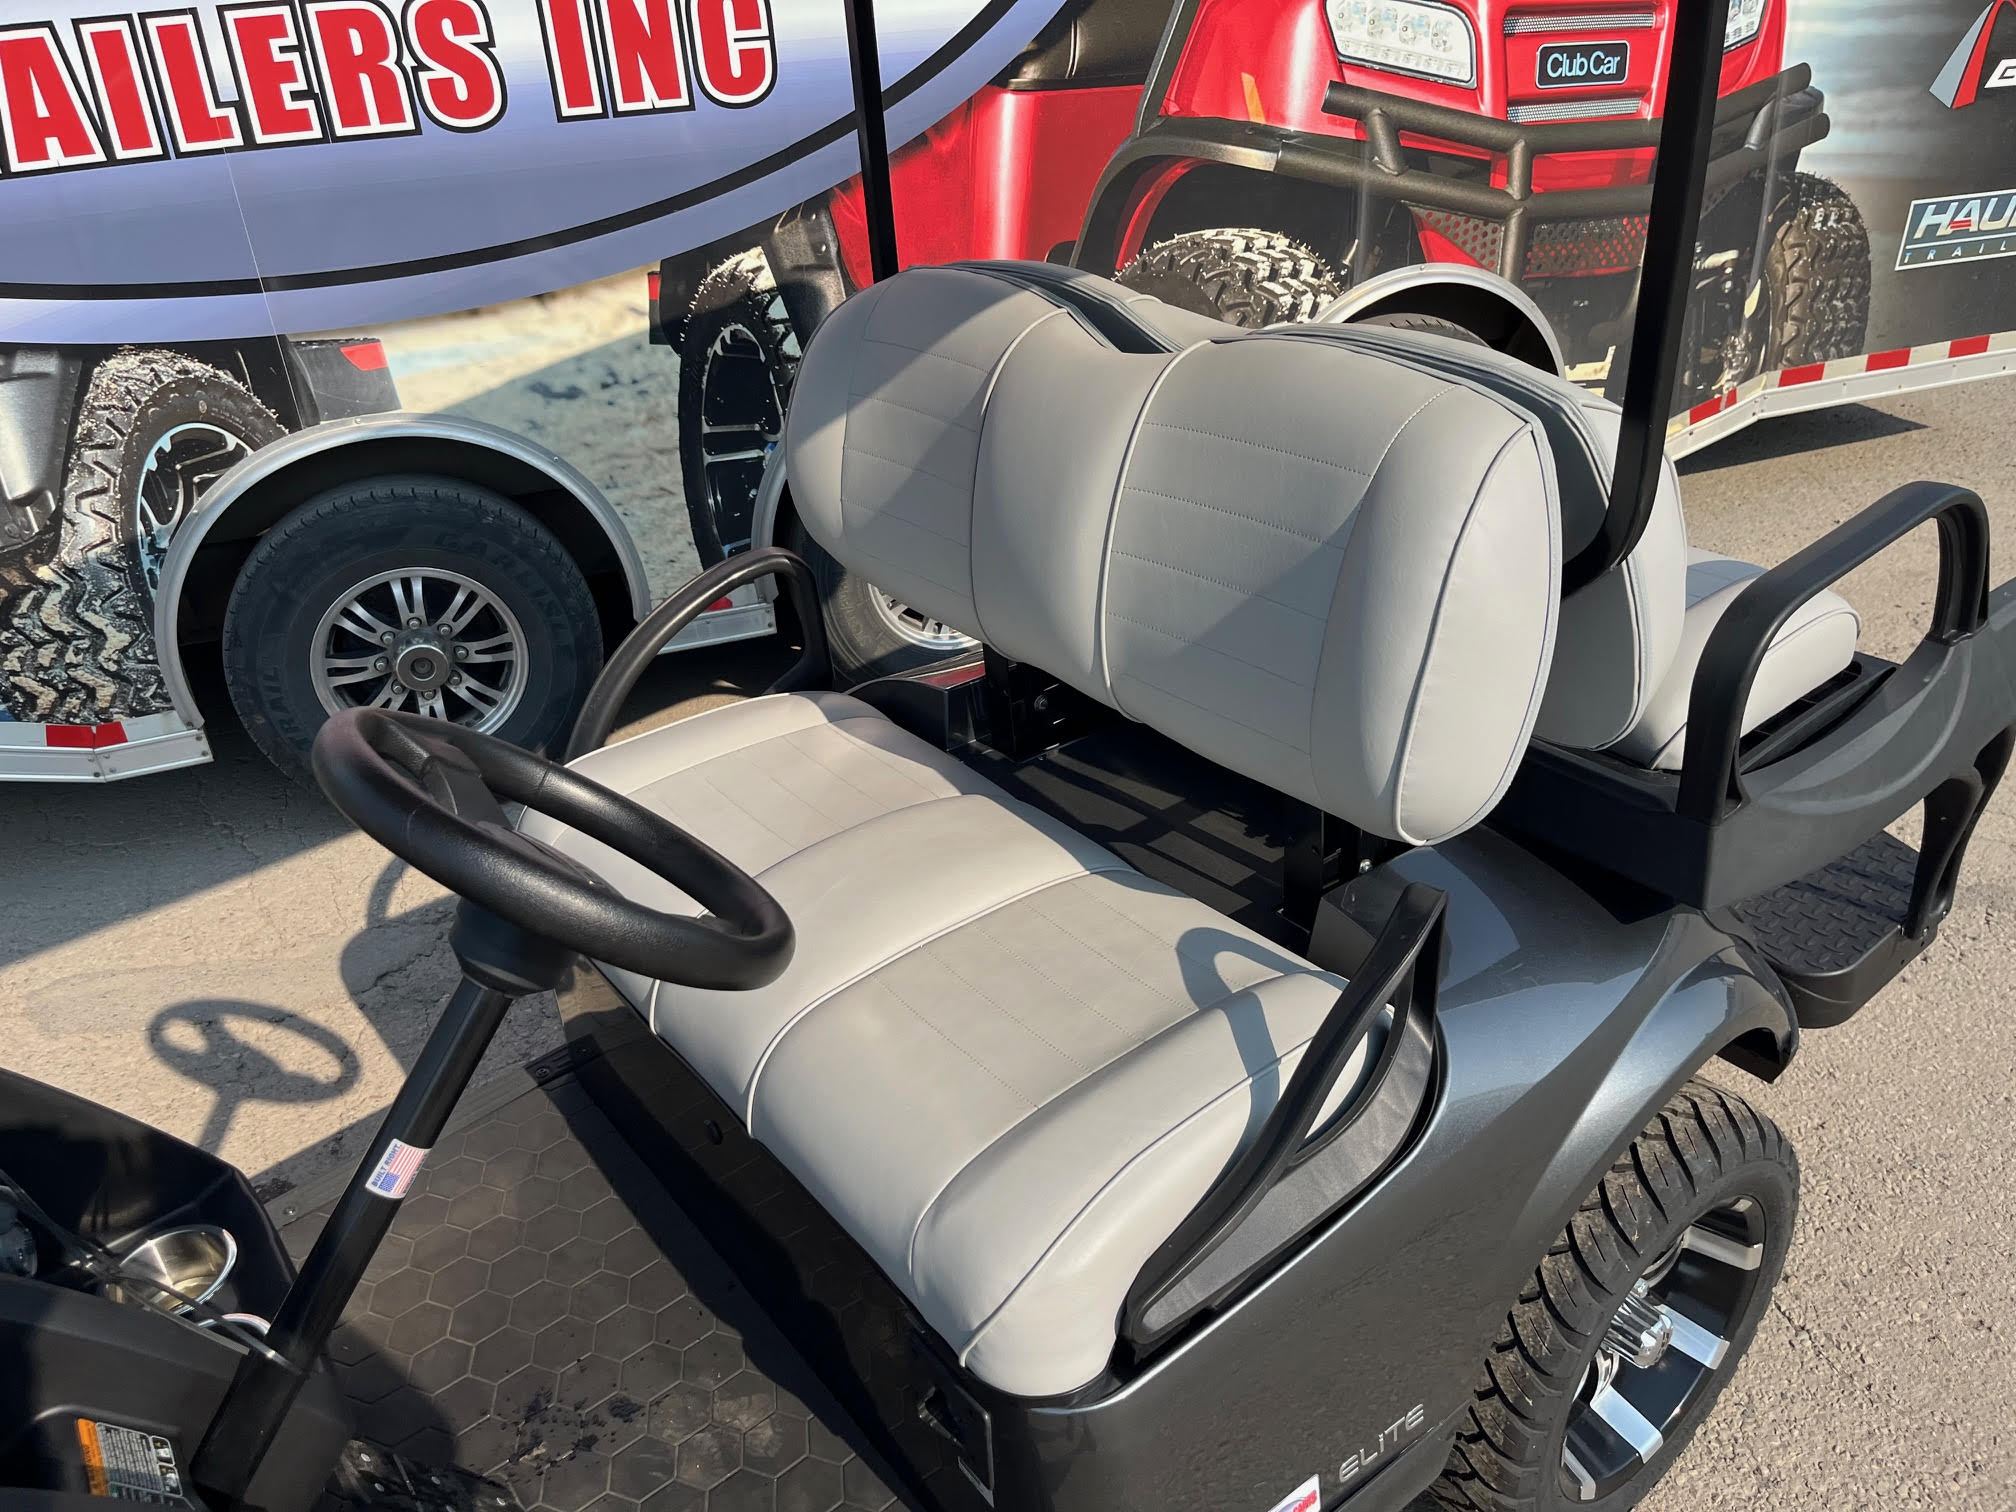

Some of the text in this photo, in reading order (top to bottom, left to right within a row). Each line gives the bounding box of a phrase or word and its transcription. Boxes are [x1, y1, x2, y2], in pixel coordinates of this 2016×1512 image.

[1546, 50, 1621, 78] Club Car
[0, 0, 778, 180] AILERS INC
[1913, 194, 2016, 239] HAU
[371, 1165, 388, 1187] BUILT
[1339, 1403, 1425, 1483] ELITE
